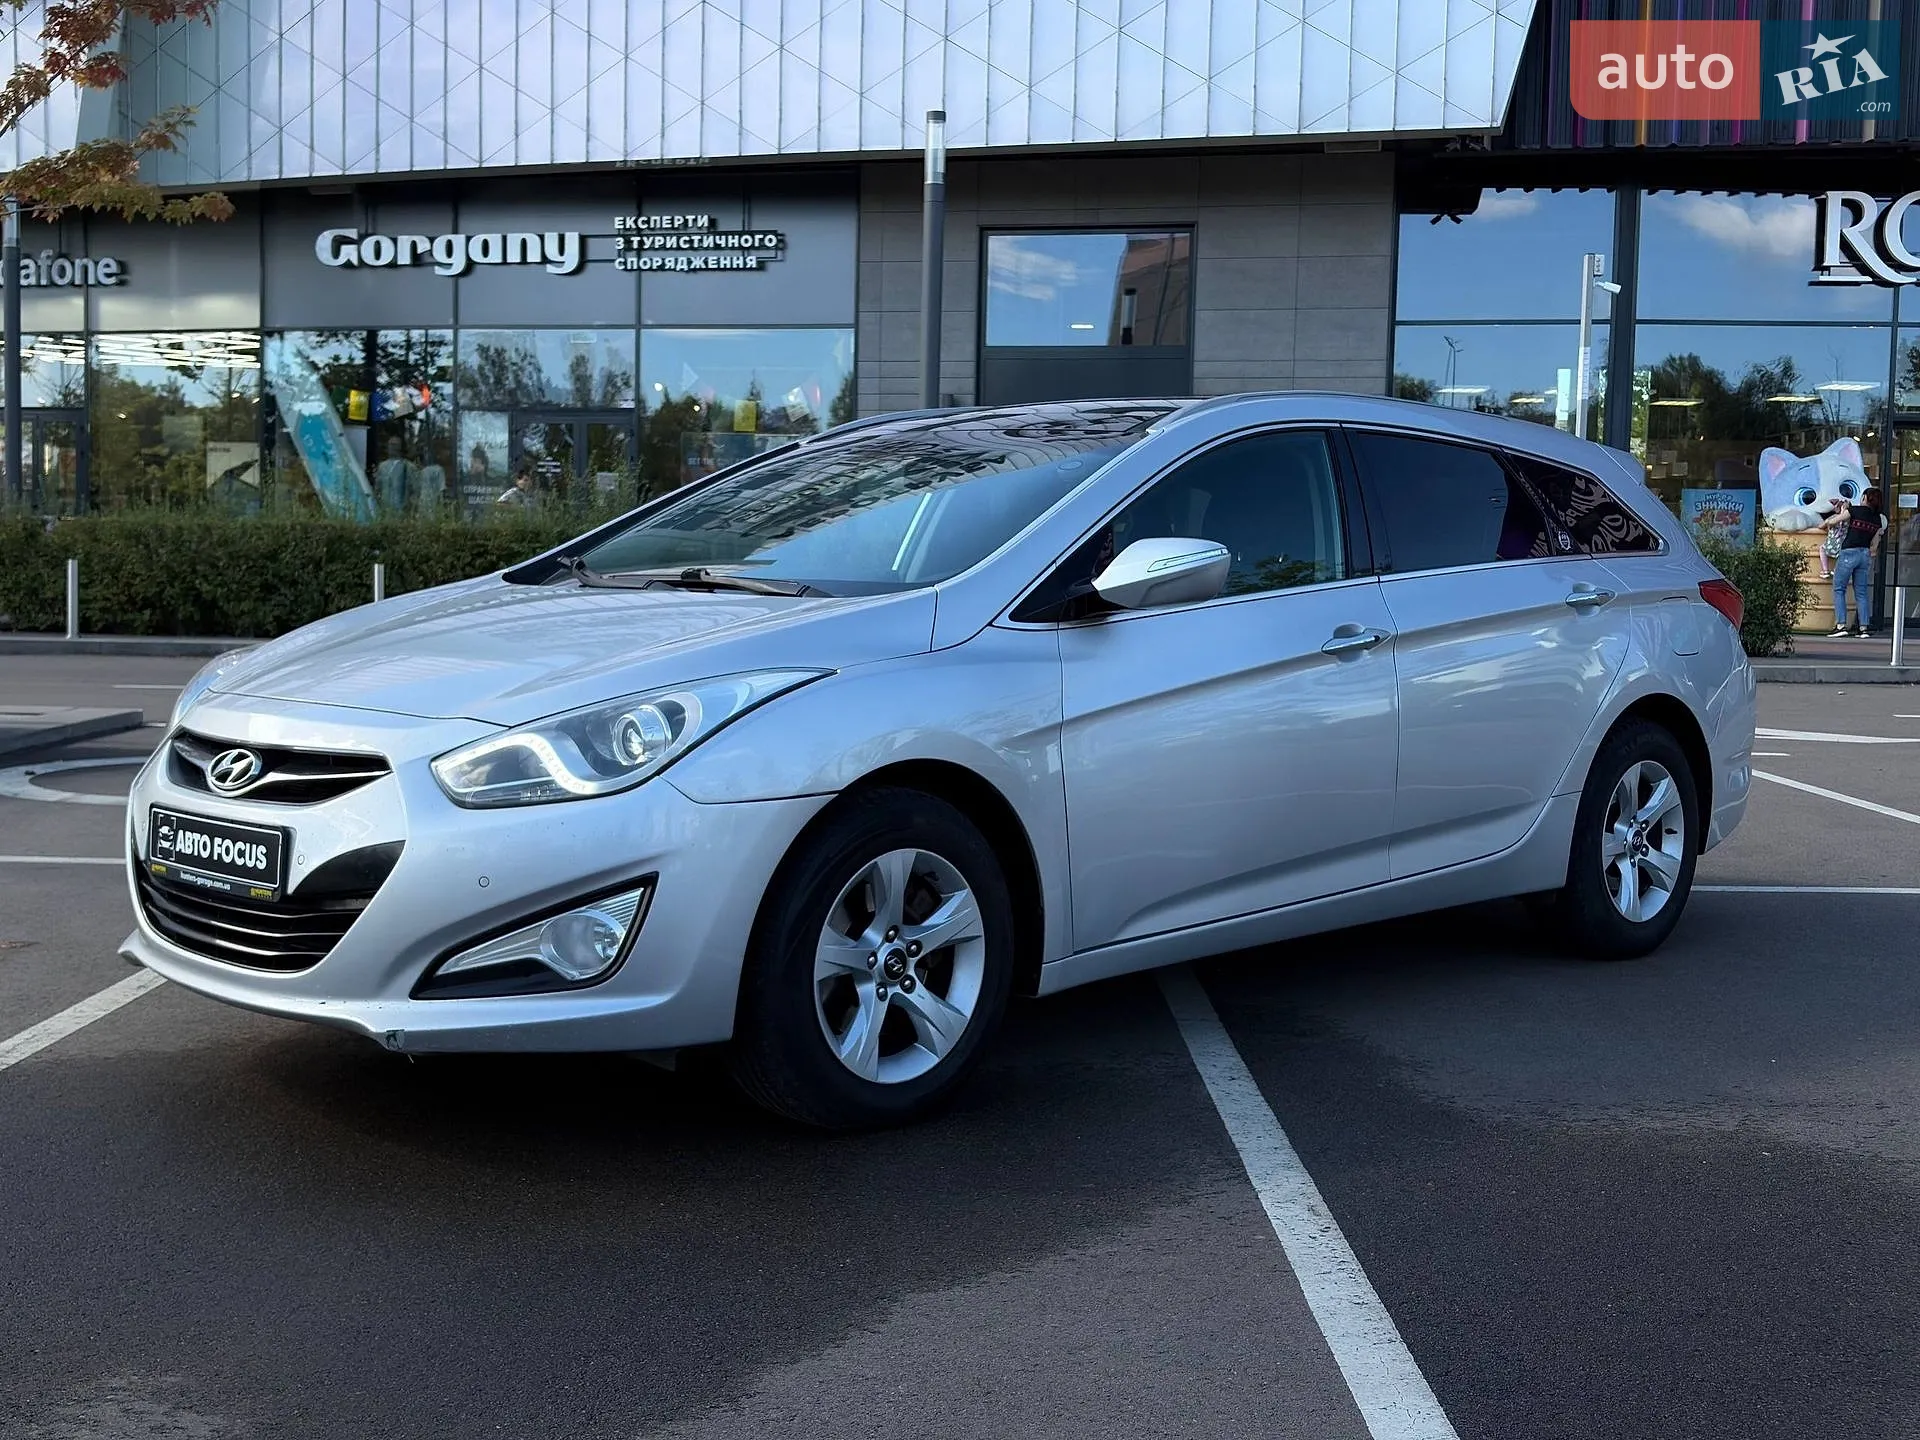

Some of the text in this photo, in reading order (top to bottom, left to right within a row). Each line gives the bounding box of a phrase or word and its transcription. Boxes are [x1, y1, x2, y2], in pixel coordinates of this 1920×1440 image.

[613, 214, 709, 229] ЕКСПЕРТИ
[630, 234, 778, 249] ТУРИСТИЧНОГО
[315, 228, 580, 276] Gorgany
[0, 249, 118, 286] afone
[614, 256, 757, 271] СПОРЯДЖЕННЯ
[1695, 500, 1744, 512] ЗНИЖКИ
[175, 829, 267, 870] АВТО FOCUS
